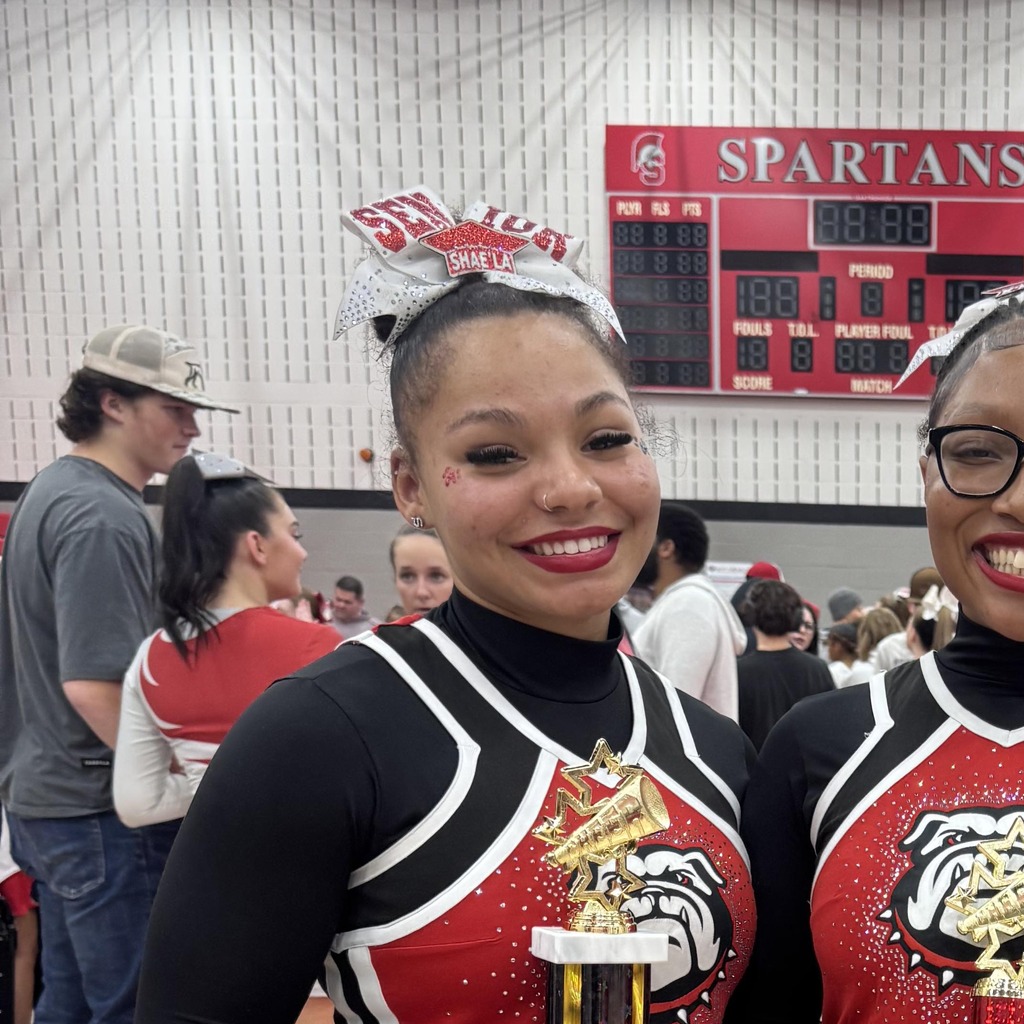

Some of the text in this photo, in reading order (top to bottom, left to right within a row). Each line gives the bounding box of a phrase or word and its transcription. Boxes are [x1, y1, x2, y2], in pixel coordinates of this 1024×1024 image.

[651, 202, 670, 216] FLS
[682, 202, 702, 217] PTS
[449, 250, 512, 272] SHAE'LA
[849, 263, 894, 279] PERIOD
[733, 322, 773, 337] FOULS
[835, 324, 914, 340] PLAYER FOUL
[733, 375, 773, 391] SCORE
[850, 378, 893, 394] MATCH
